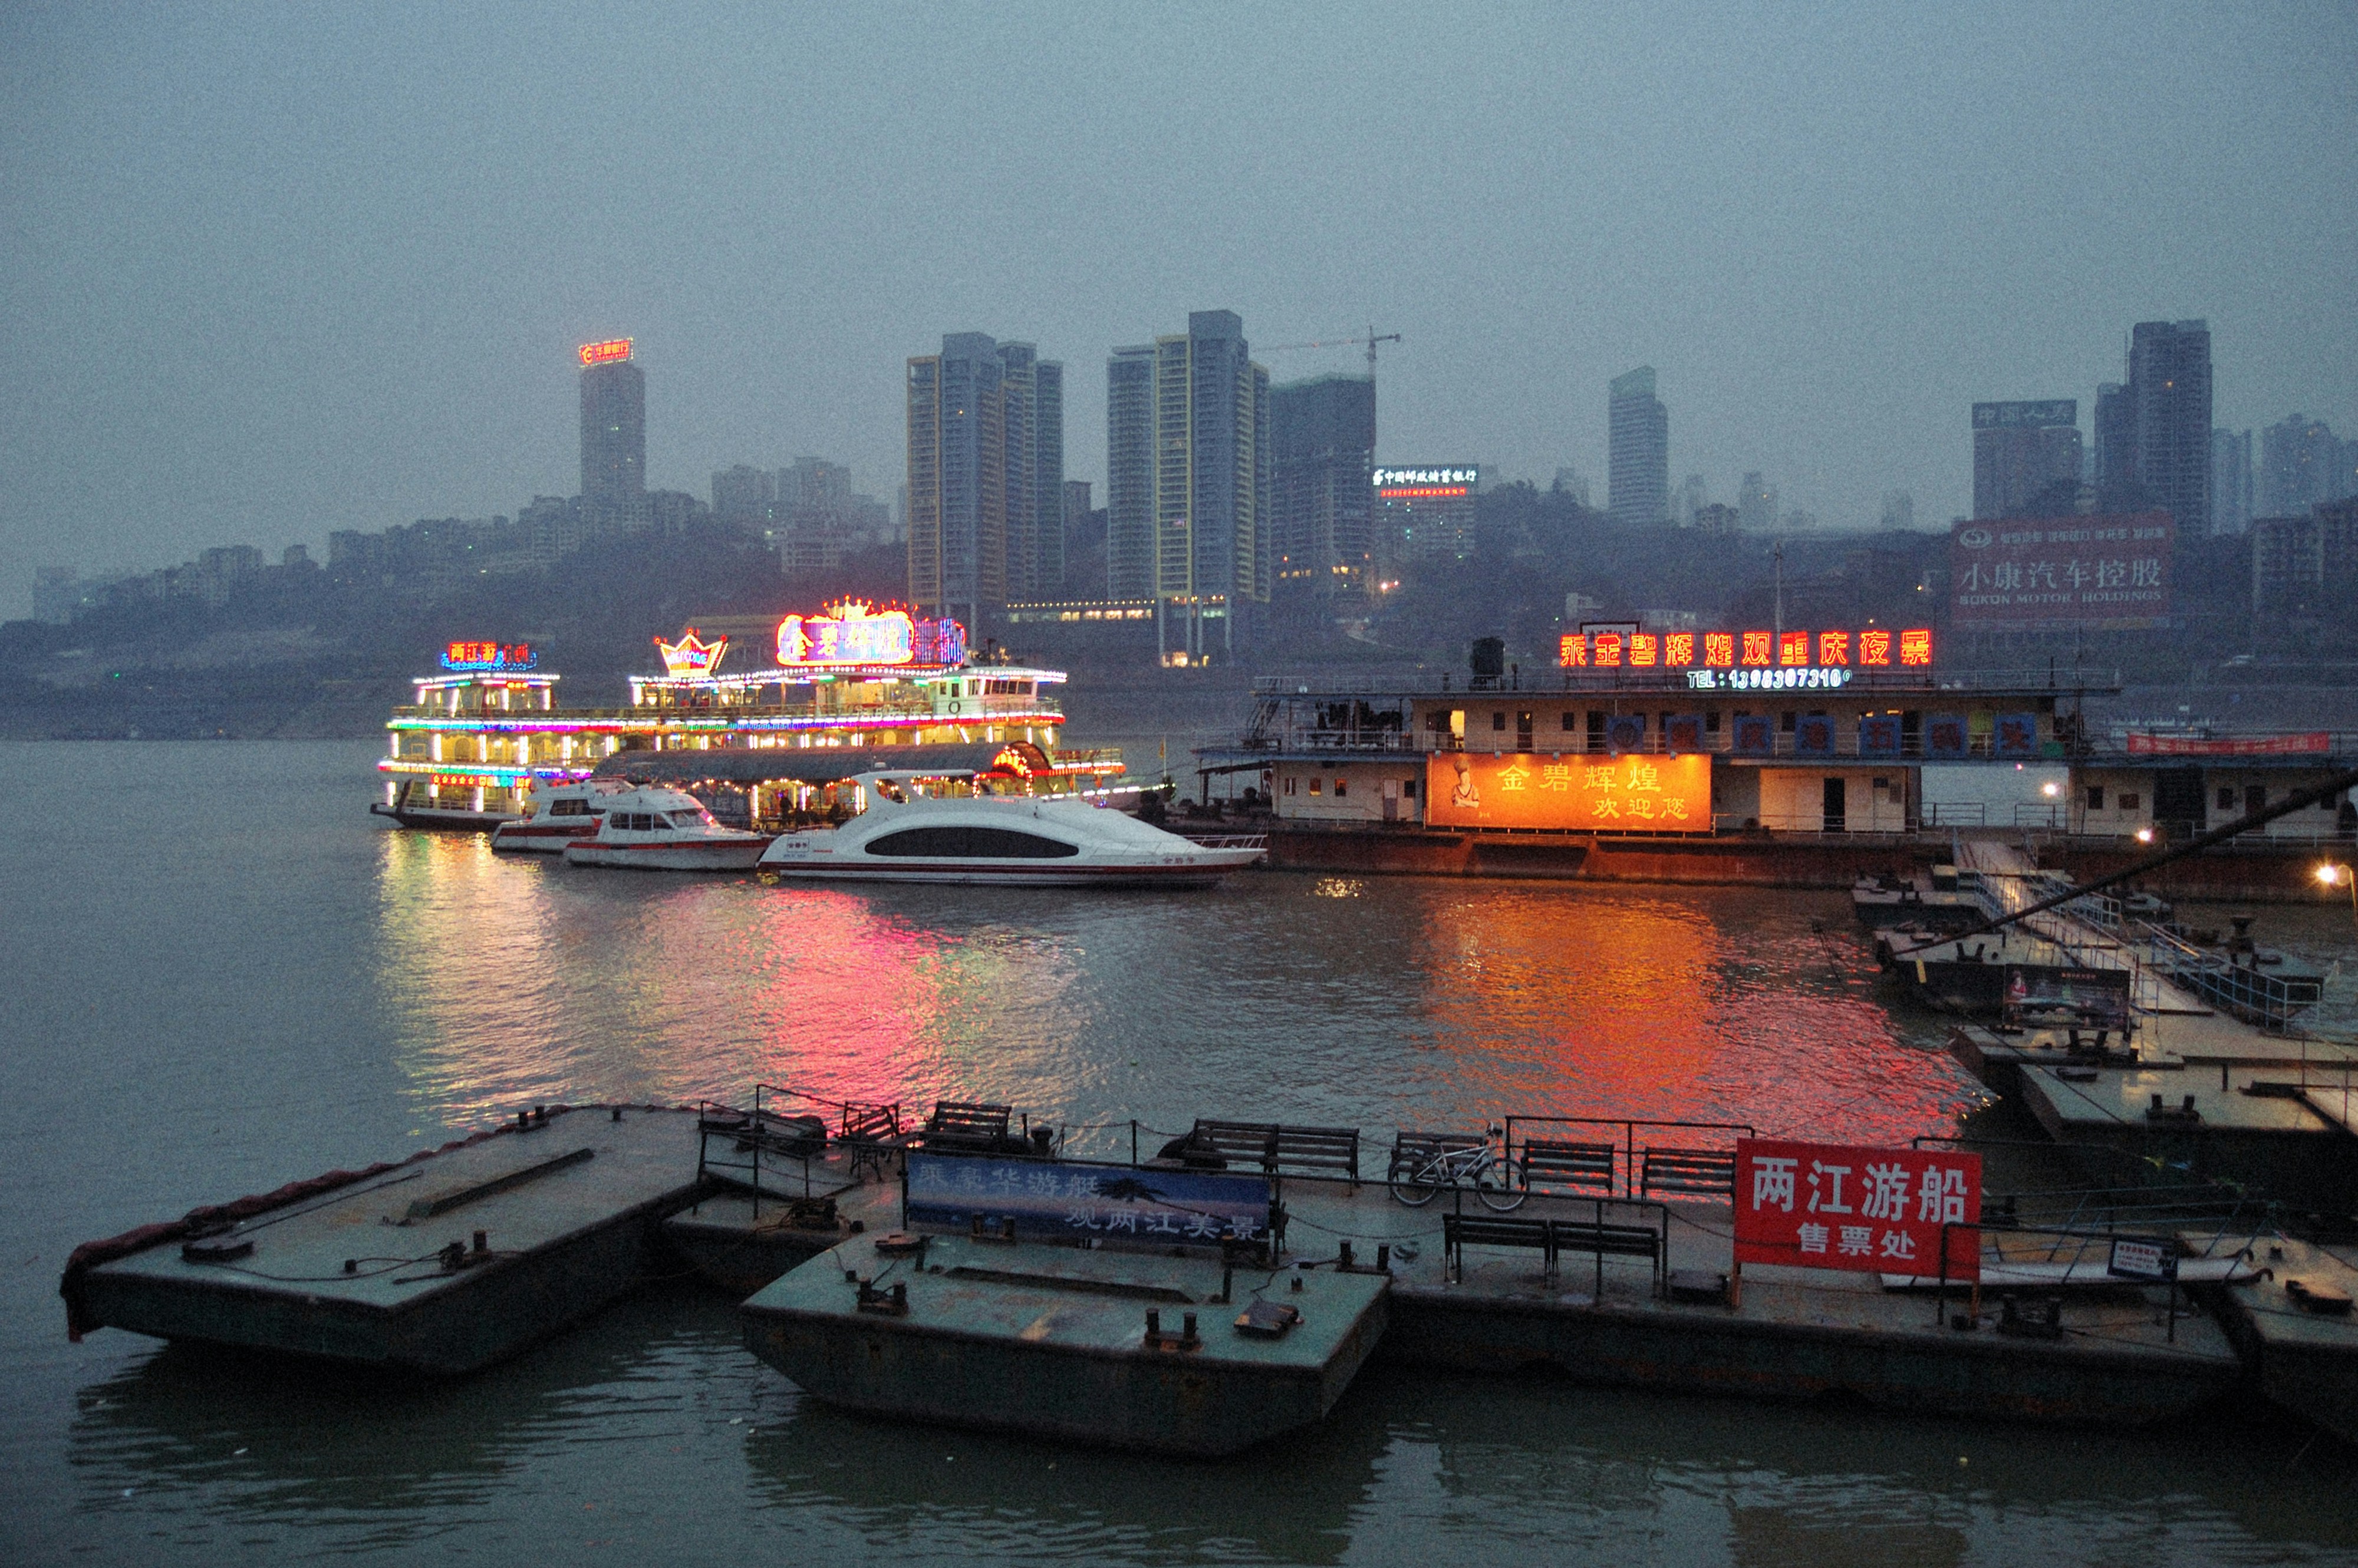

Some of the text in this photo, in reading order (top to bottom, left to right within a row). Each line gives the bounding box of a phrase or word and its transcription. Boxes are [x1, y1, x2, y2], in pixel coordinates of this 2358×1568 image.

[1960, 558, 2162, 590] 小康汽车控股
[2016, 592, 2072, 604] MOTOR
[2082, 590, 2162, 603] HOLDINGS
[450, 643, 496, 662] 两江游
[1560, 631, 1931, 666] 乘金碧辉煌观重庆夜景
[1497, 763, 1662, 792] 金碧辉煌
[1592, 797, 1689, 820] 欢迎您
[918, 1162, 1101, 1200] 乘豪华游艇
[1752, 1156, 1967, 1224] 两江游船
[1065, 1205, 1262, 1241] 观两江美景
[1797, 1222, 1915, 1260] 售票处
